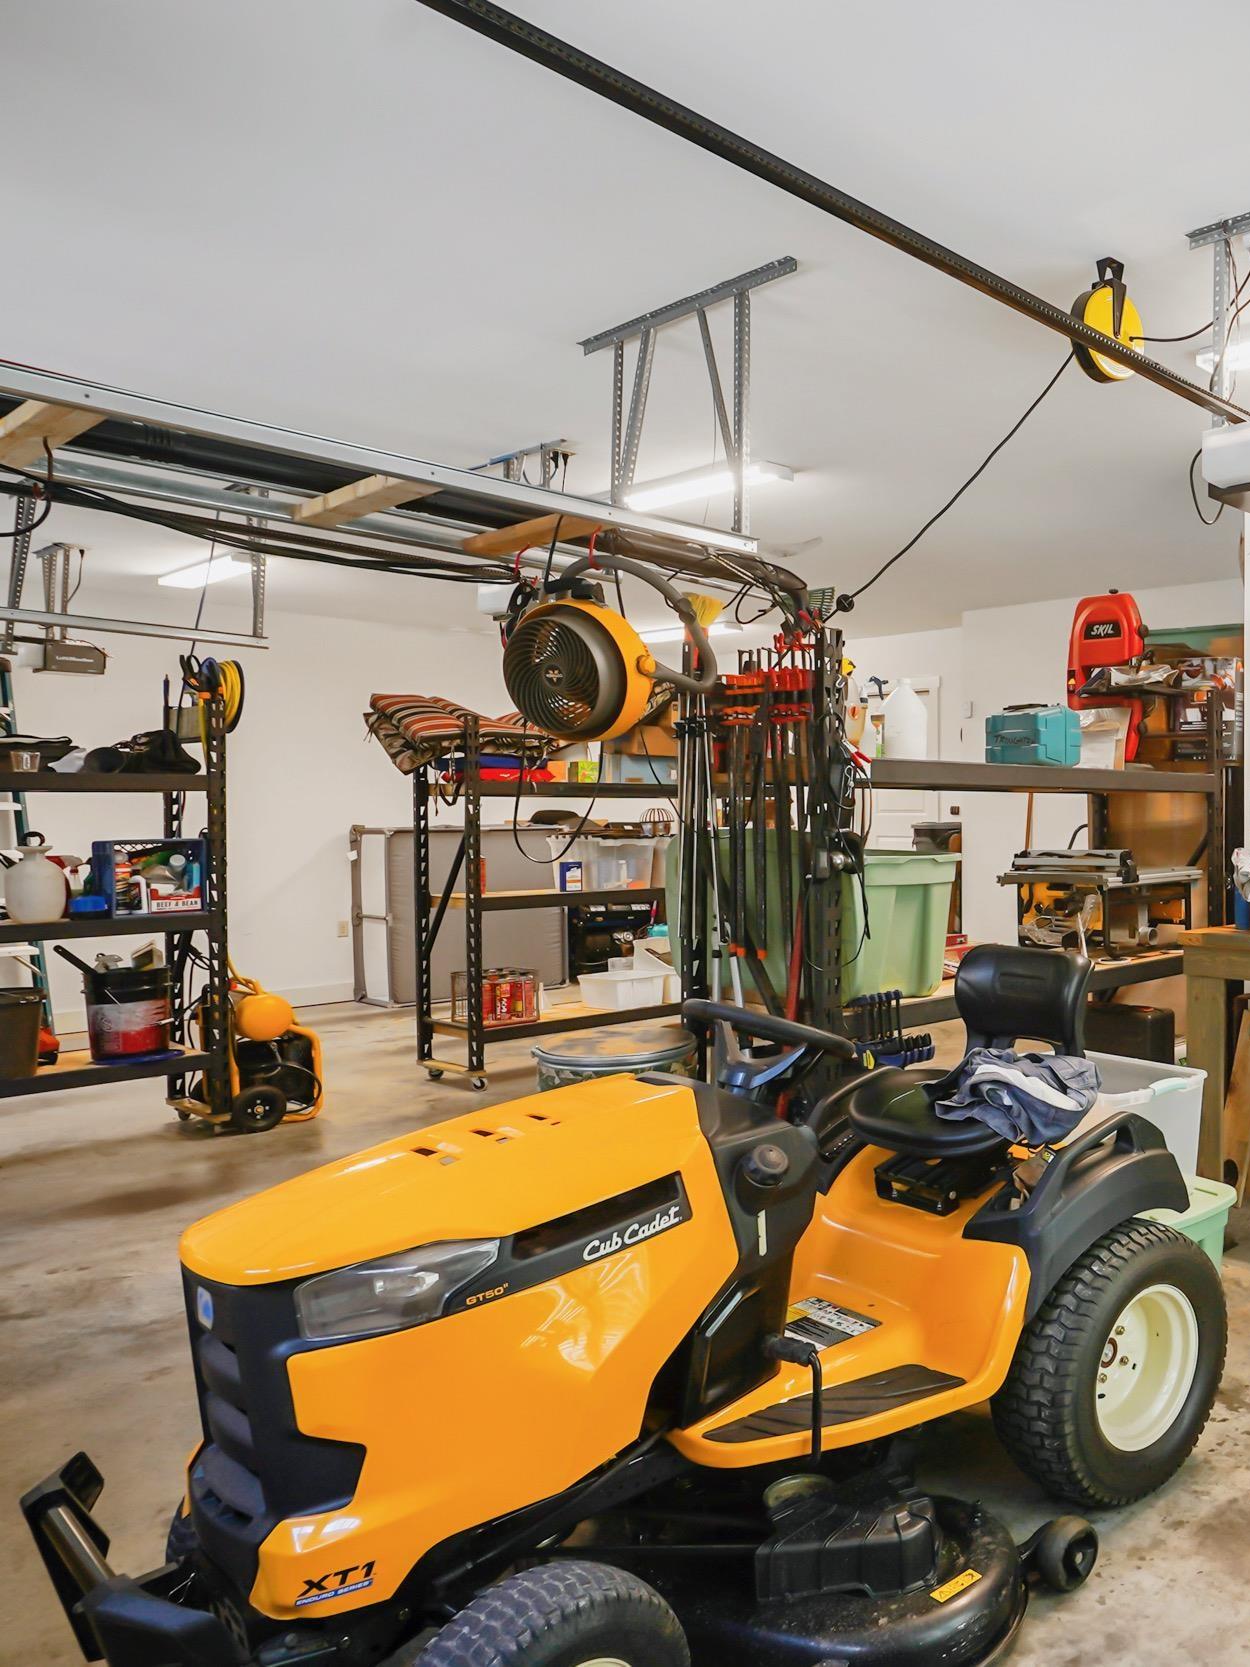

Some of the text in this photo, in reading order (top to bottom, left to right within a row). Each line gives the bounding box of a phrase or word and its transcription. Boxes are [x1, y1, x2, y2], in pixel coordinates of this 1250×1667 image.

[1091, 623, 1115, 637] SKIL
[583, 1206, 681, 1261] Cub Cadet
[296, 1580, 372, 1606] ENDURO SERIES
[297, 1560, 376, 1598] XT1
